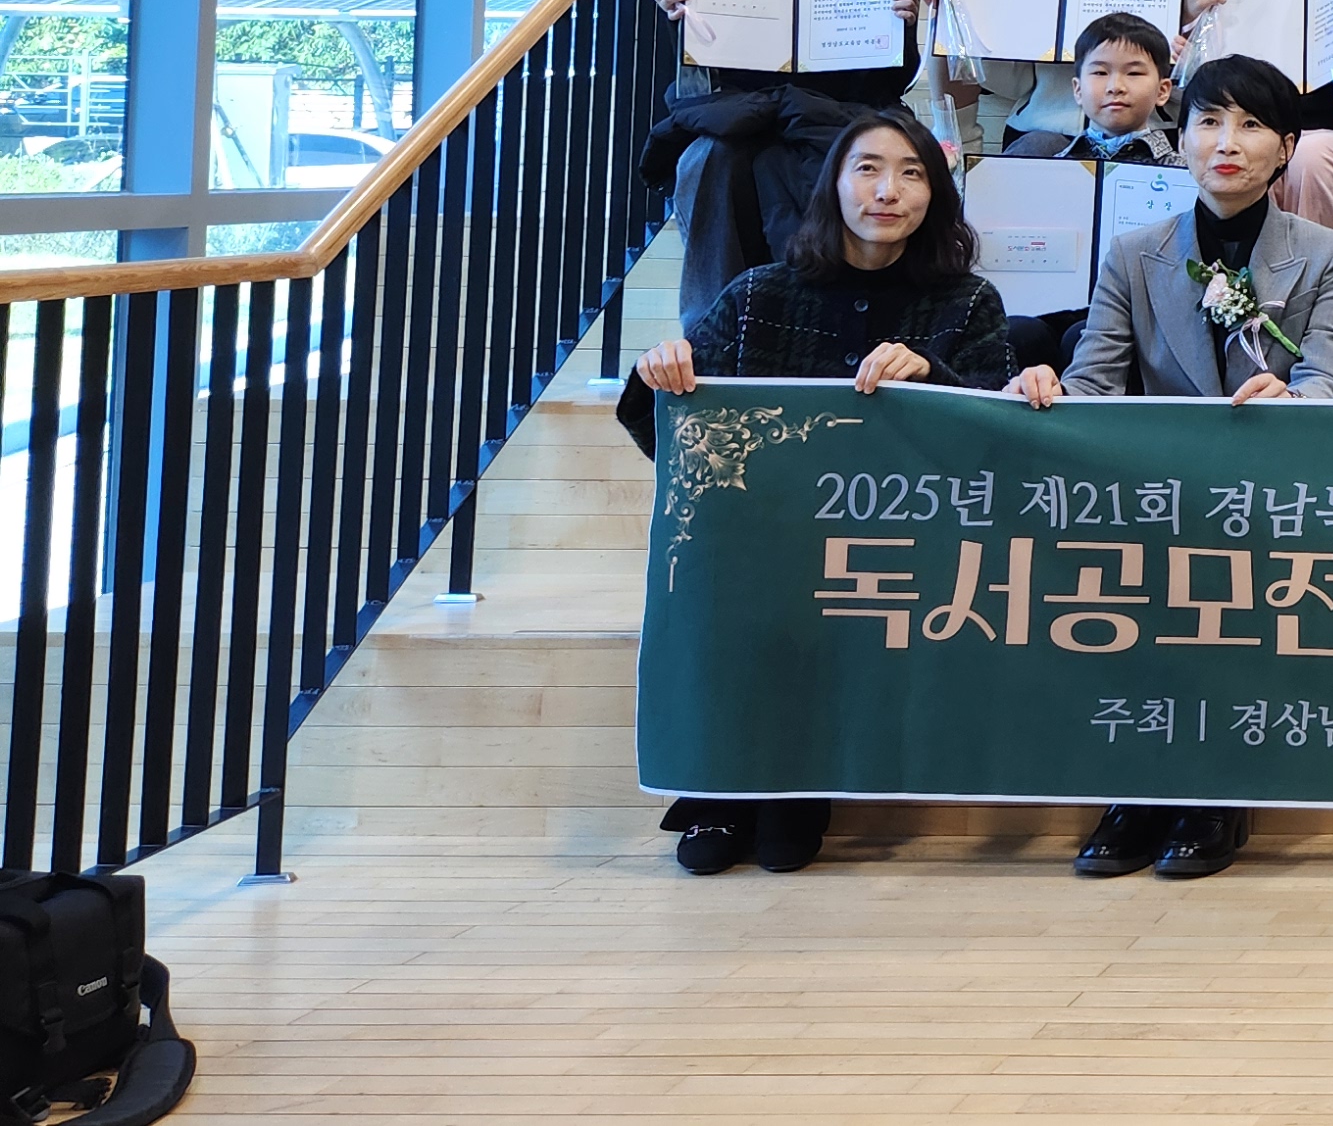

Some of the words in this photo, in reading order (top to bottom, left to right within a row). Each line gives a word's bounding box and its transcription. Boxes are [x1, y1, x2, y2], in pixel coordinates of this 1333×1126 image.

[813, 469, 995, 526] 2025년
[1018, 474, 1183, 535] 제21회
[1090, 698, 1175, 744] 주최
[77, 976, 108, 996] Canon
